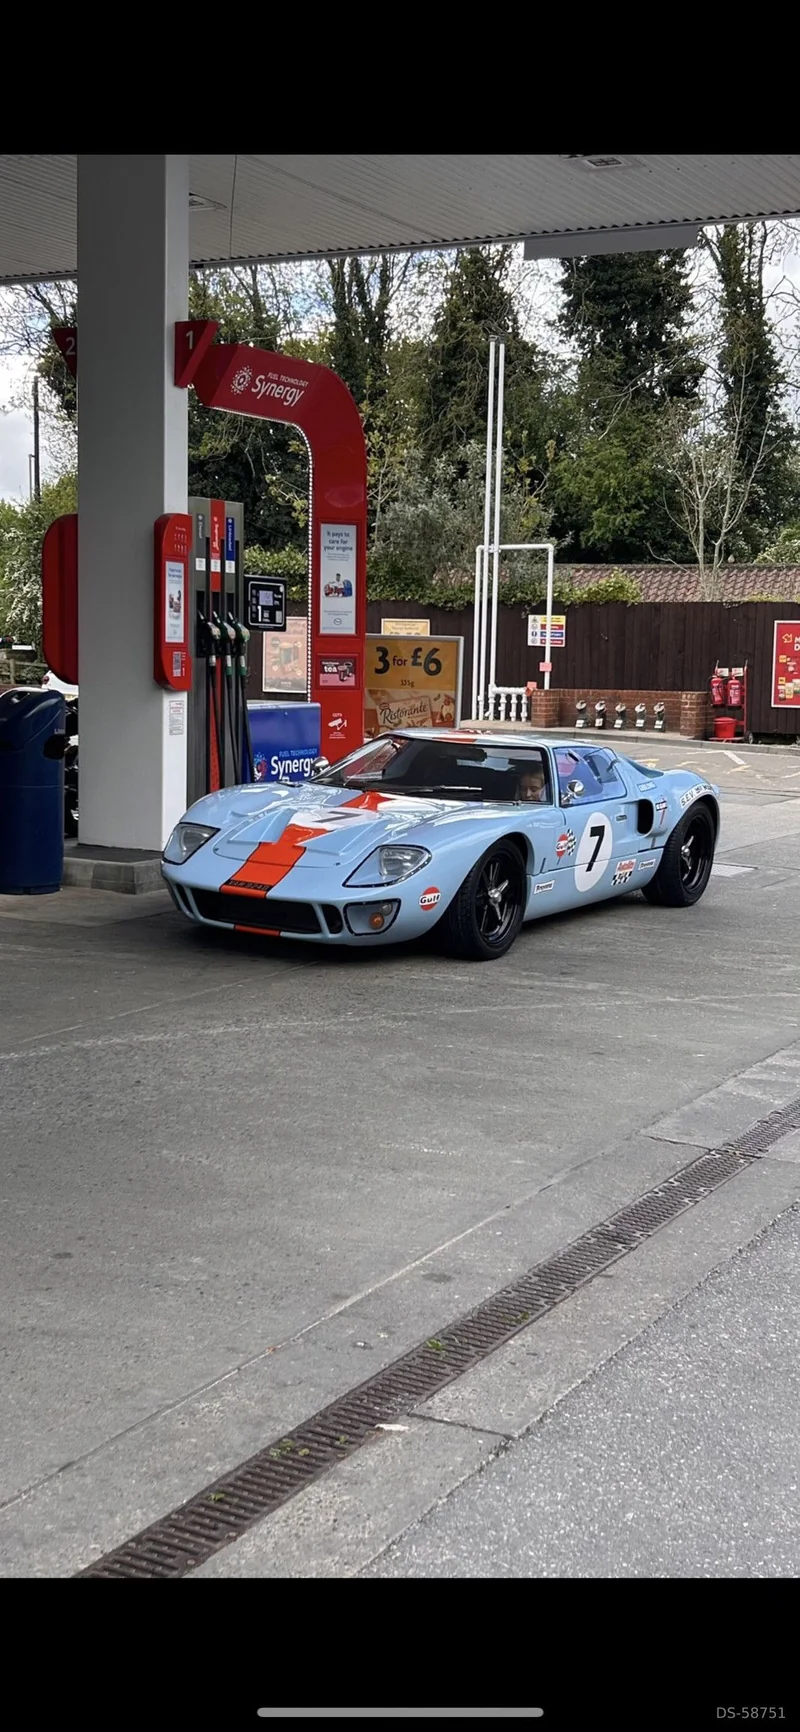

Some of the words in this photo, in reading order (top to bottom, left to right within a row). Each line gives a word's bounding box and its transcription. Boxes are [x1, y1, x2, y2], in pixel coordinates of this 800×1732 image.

[65, 337, 75, 356] 2
[185, 330, 193, 350] 1
[267, 372, 279, 380] FUEL
[280, 375, 309, 387] TECHNOLOGY
[251, 375, 305, 407] Synergy
[257, 605, 262, 622] 1
[374, 646, 390, 675] 3
[392, 655, 408, 667] for
[411, 647, 442, 676] £6
[380, 701, 427, 724] Ristorante
[290, 748, 318, 757] TECHNOLOGY
[585, 825, 605, 872] 7
[419, 894, 440, 904] Gulf
